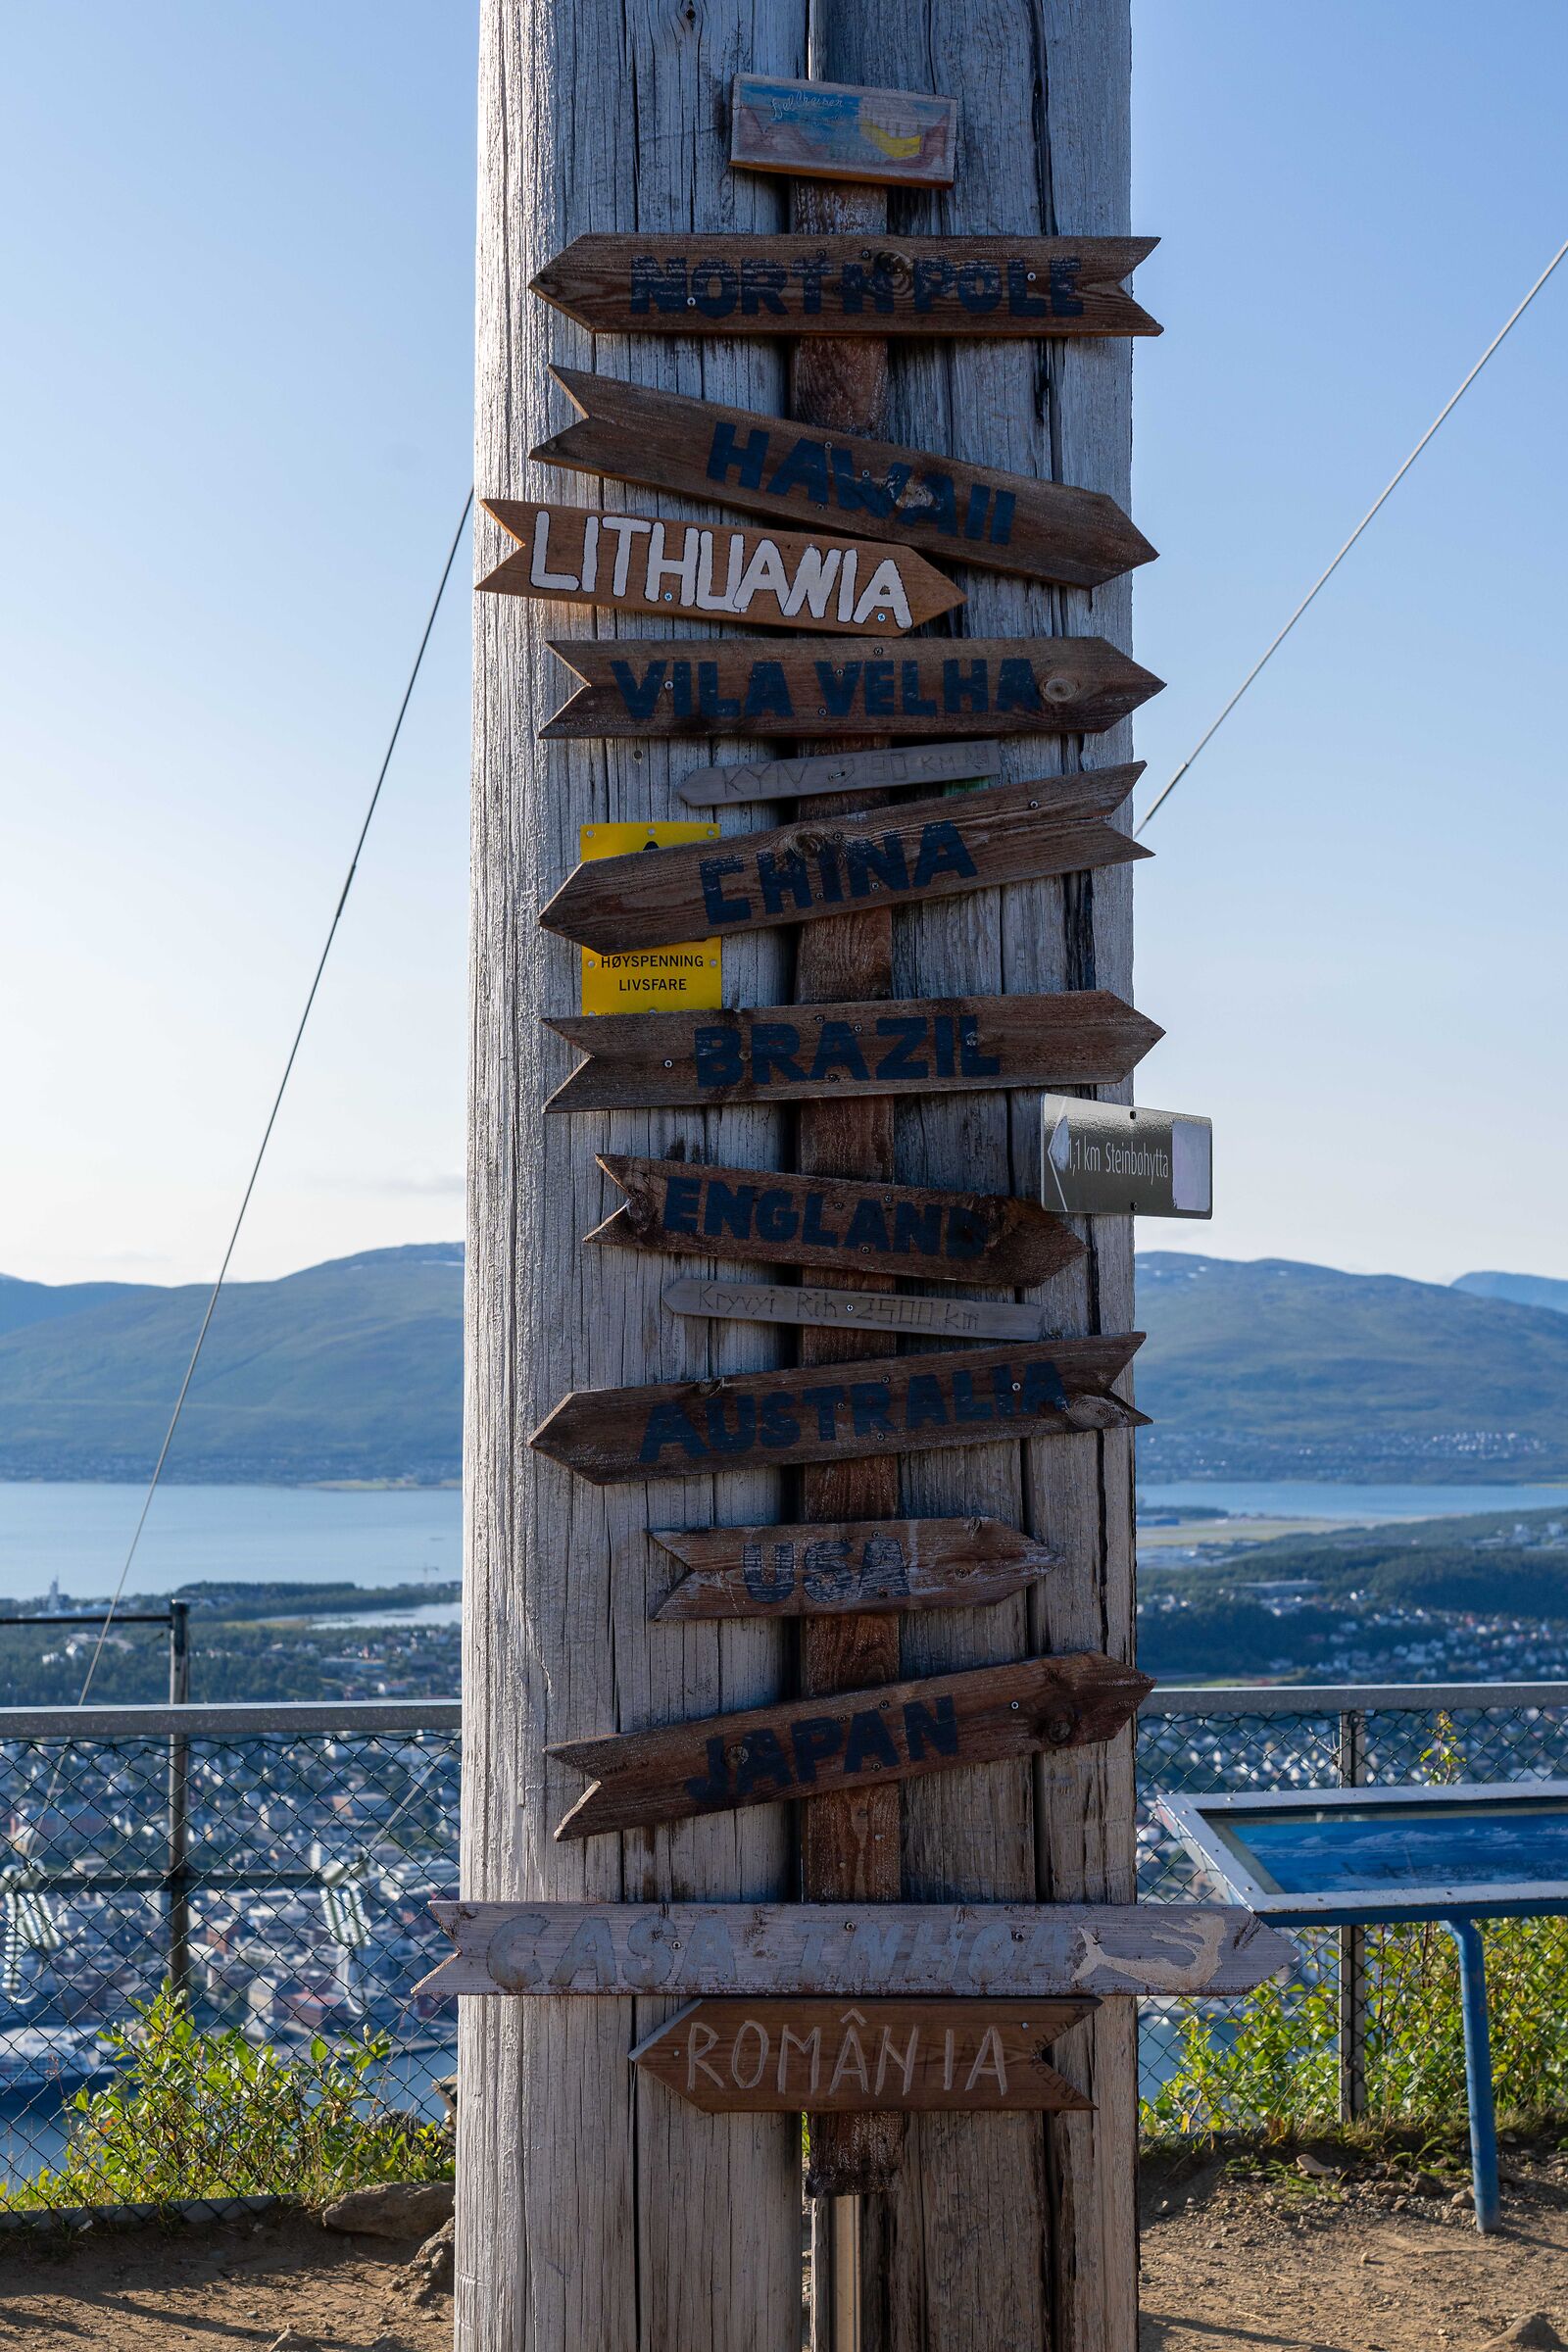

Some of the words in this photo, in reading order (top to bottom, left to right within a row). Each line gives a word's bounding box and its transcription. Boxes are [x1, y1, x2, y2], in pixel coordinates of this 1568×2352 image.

[630, 255, 895, 318] NORTH
[913, 257, 1085, 318] POLE
[706, 423, 1017, 546] HAWAII
[530, 510, 914, 631] LITHUANIA
[609, 660, 795, 720] VILA
[814, 658, 1044, 716] VELHA
[721, 762, 808, 798] KYIV
[698, 820, 978, 926] CHINA
[601, 955, 704, 968] HØYSPENNING
[618, 978, 687, 992] LIVSFARE
[693, 1014, 1000, 1088] BRAZIL
[1084, 1135, 1101, 1172] km
[1105, 1141, 1169, 1186] Steinbøhytta
[662, 1176, 988, 1260] ENGLAND
[855, 1296, 934, 1327] 2500
[639, 1360, 1070, 1464] AUSTRALIA
[742, 1537, 911, 1604] USA
[684, 1695, 960, 1805] JAPAN
[487, 1911, 738, 1990] CASA
[685, 2007, 1009, 2097] ROMÂNIA
